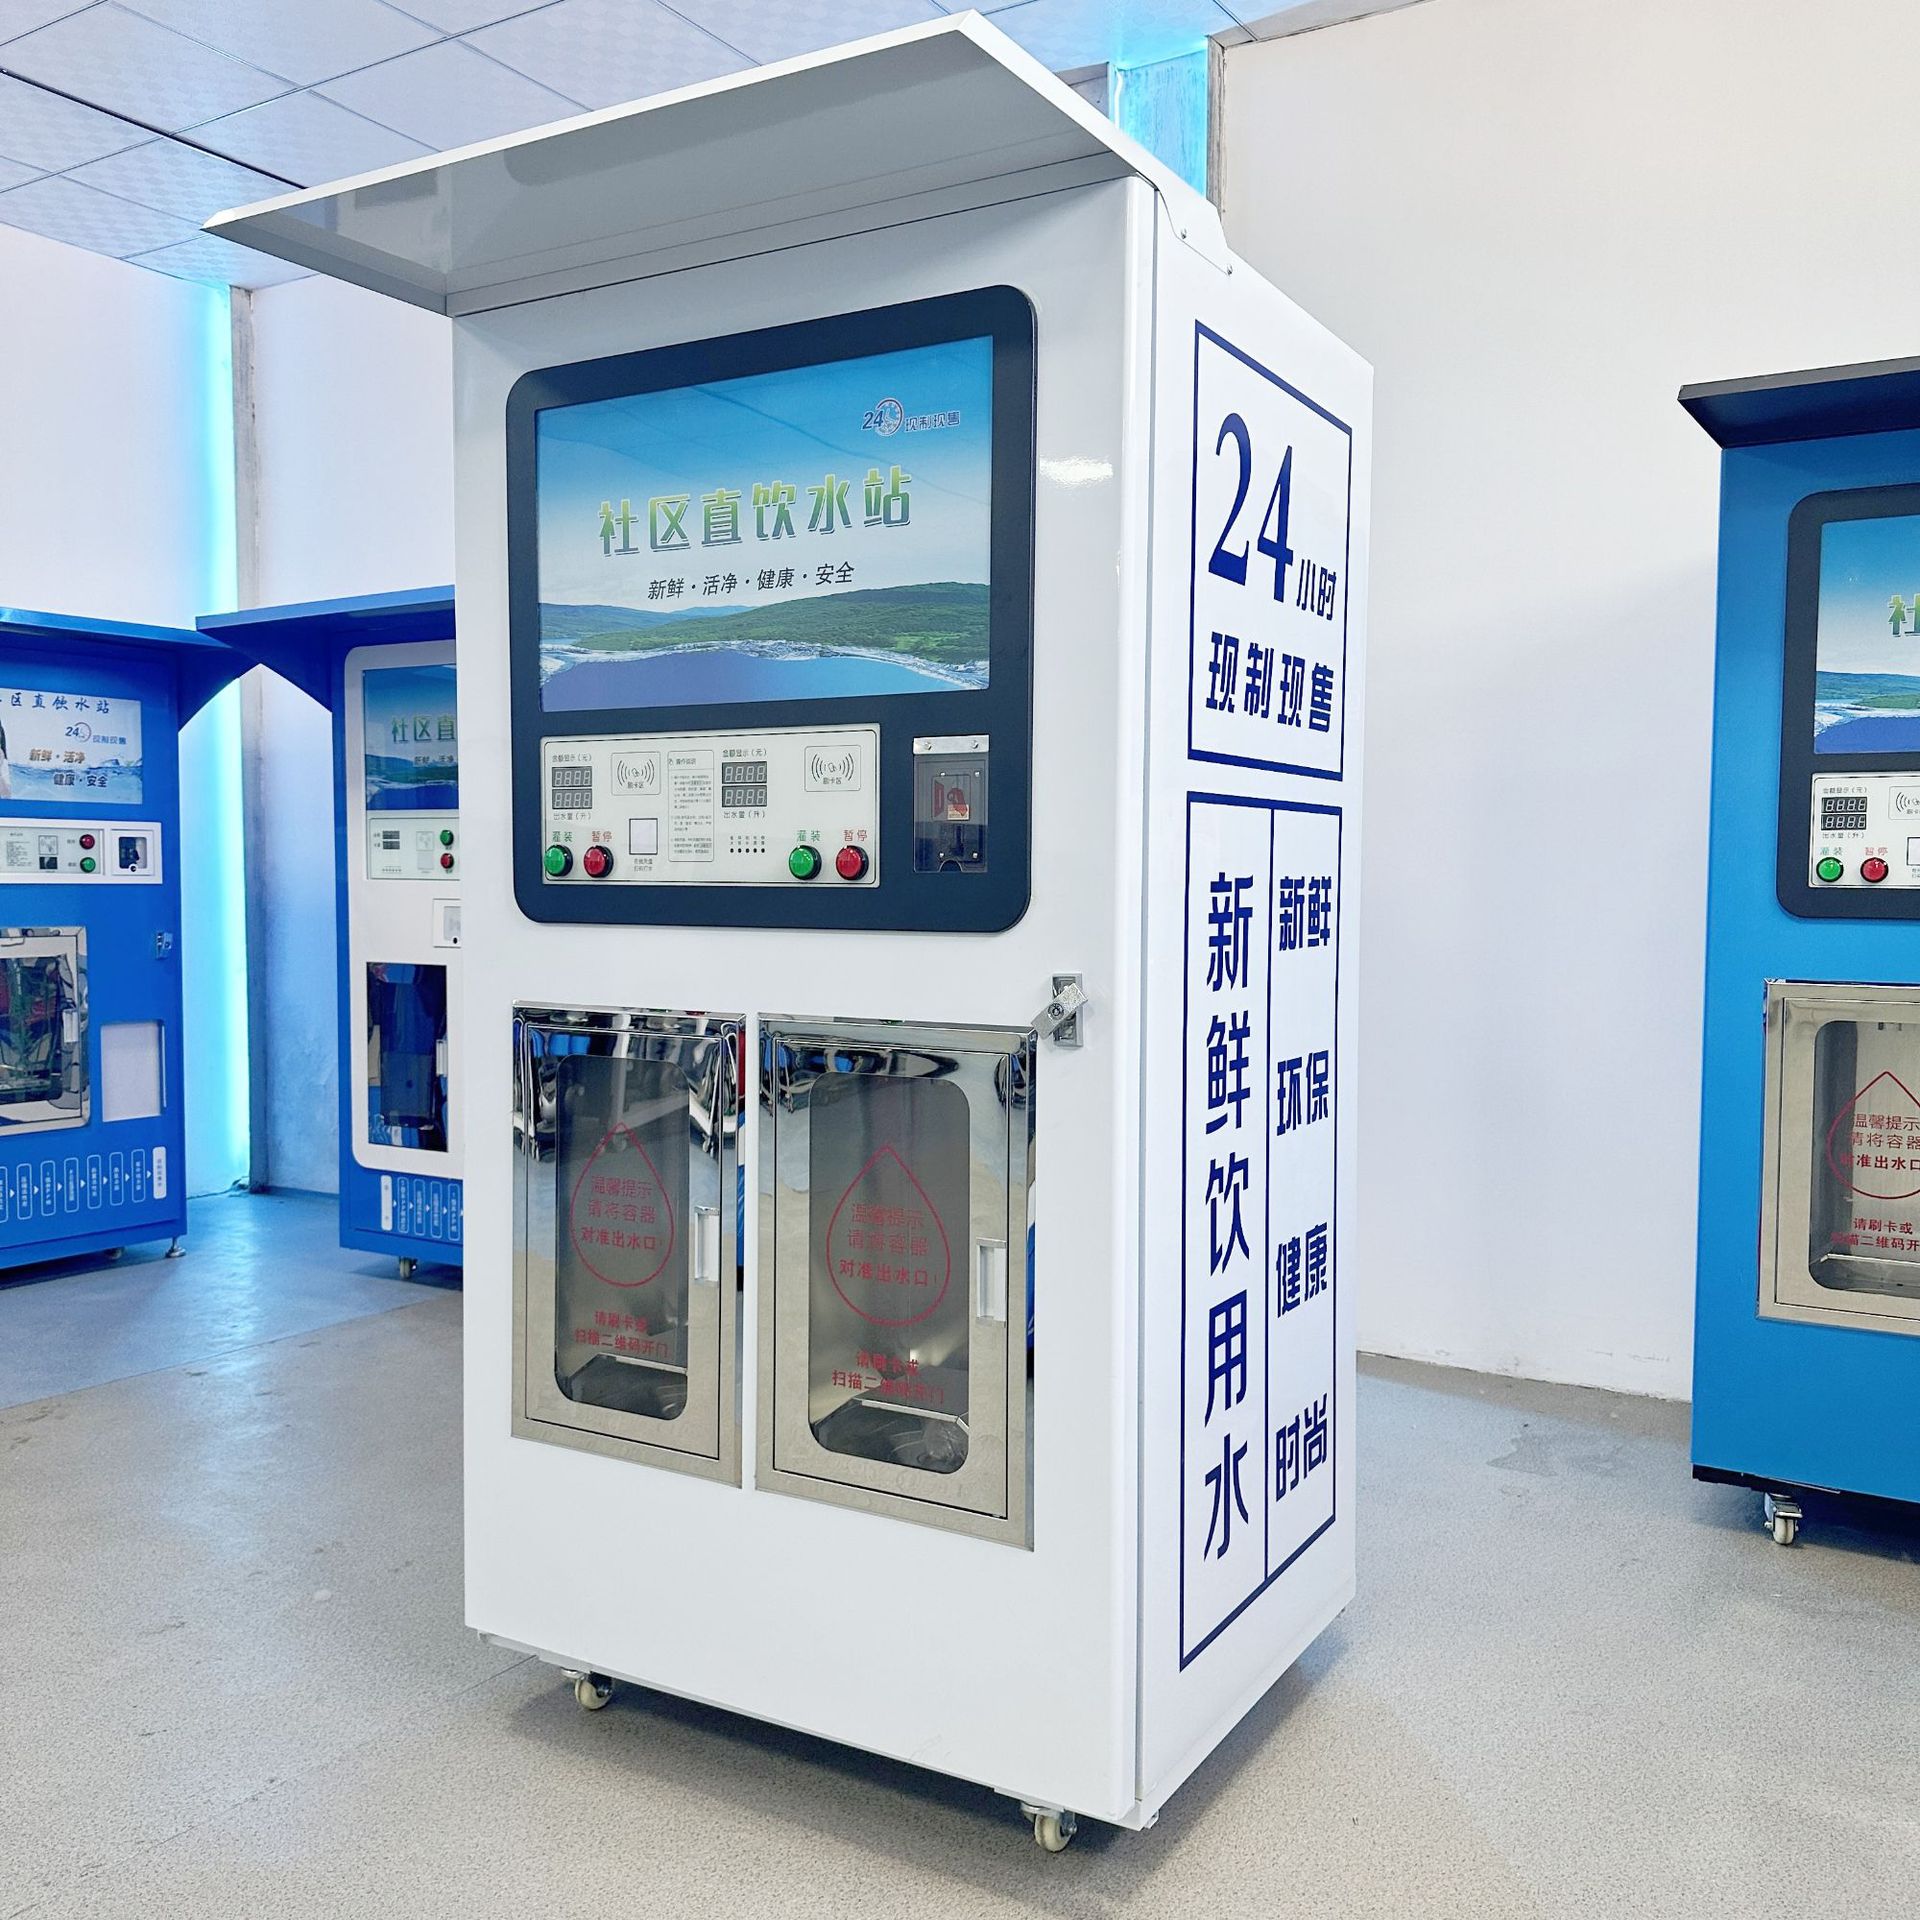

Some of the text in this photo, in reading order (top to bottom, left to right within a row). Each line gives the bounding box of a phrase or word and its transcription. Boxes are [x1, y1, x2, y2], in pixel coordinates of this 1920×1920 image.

[861, 409, 961, 433] 24 现制现售
[599, 465, 913, 557] 社区直饮水站
[0, 691, 110, 714] 区直饮水站
[1205, 631, 1335, 733] 现制现售
[844, 830, 868, 842] 暂停
[1277, 874, 1333, 953] 新鲜
[1275, 1050, 1331, 1138] 环保
[1202, 871, 1254, 1563] 新鲜饮用水
[1852, 1217, 1914, 1235] 请刷卡或
[1273, 1220, 1328, 1321] 健康
[1273, 1391, 1328, 1506] 时尚
